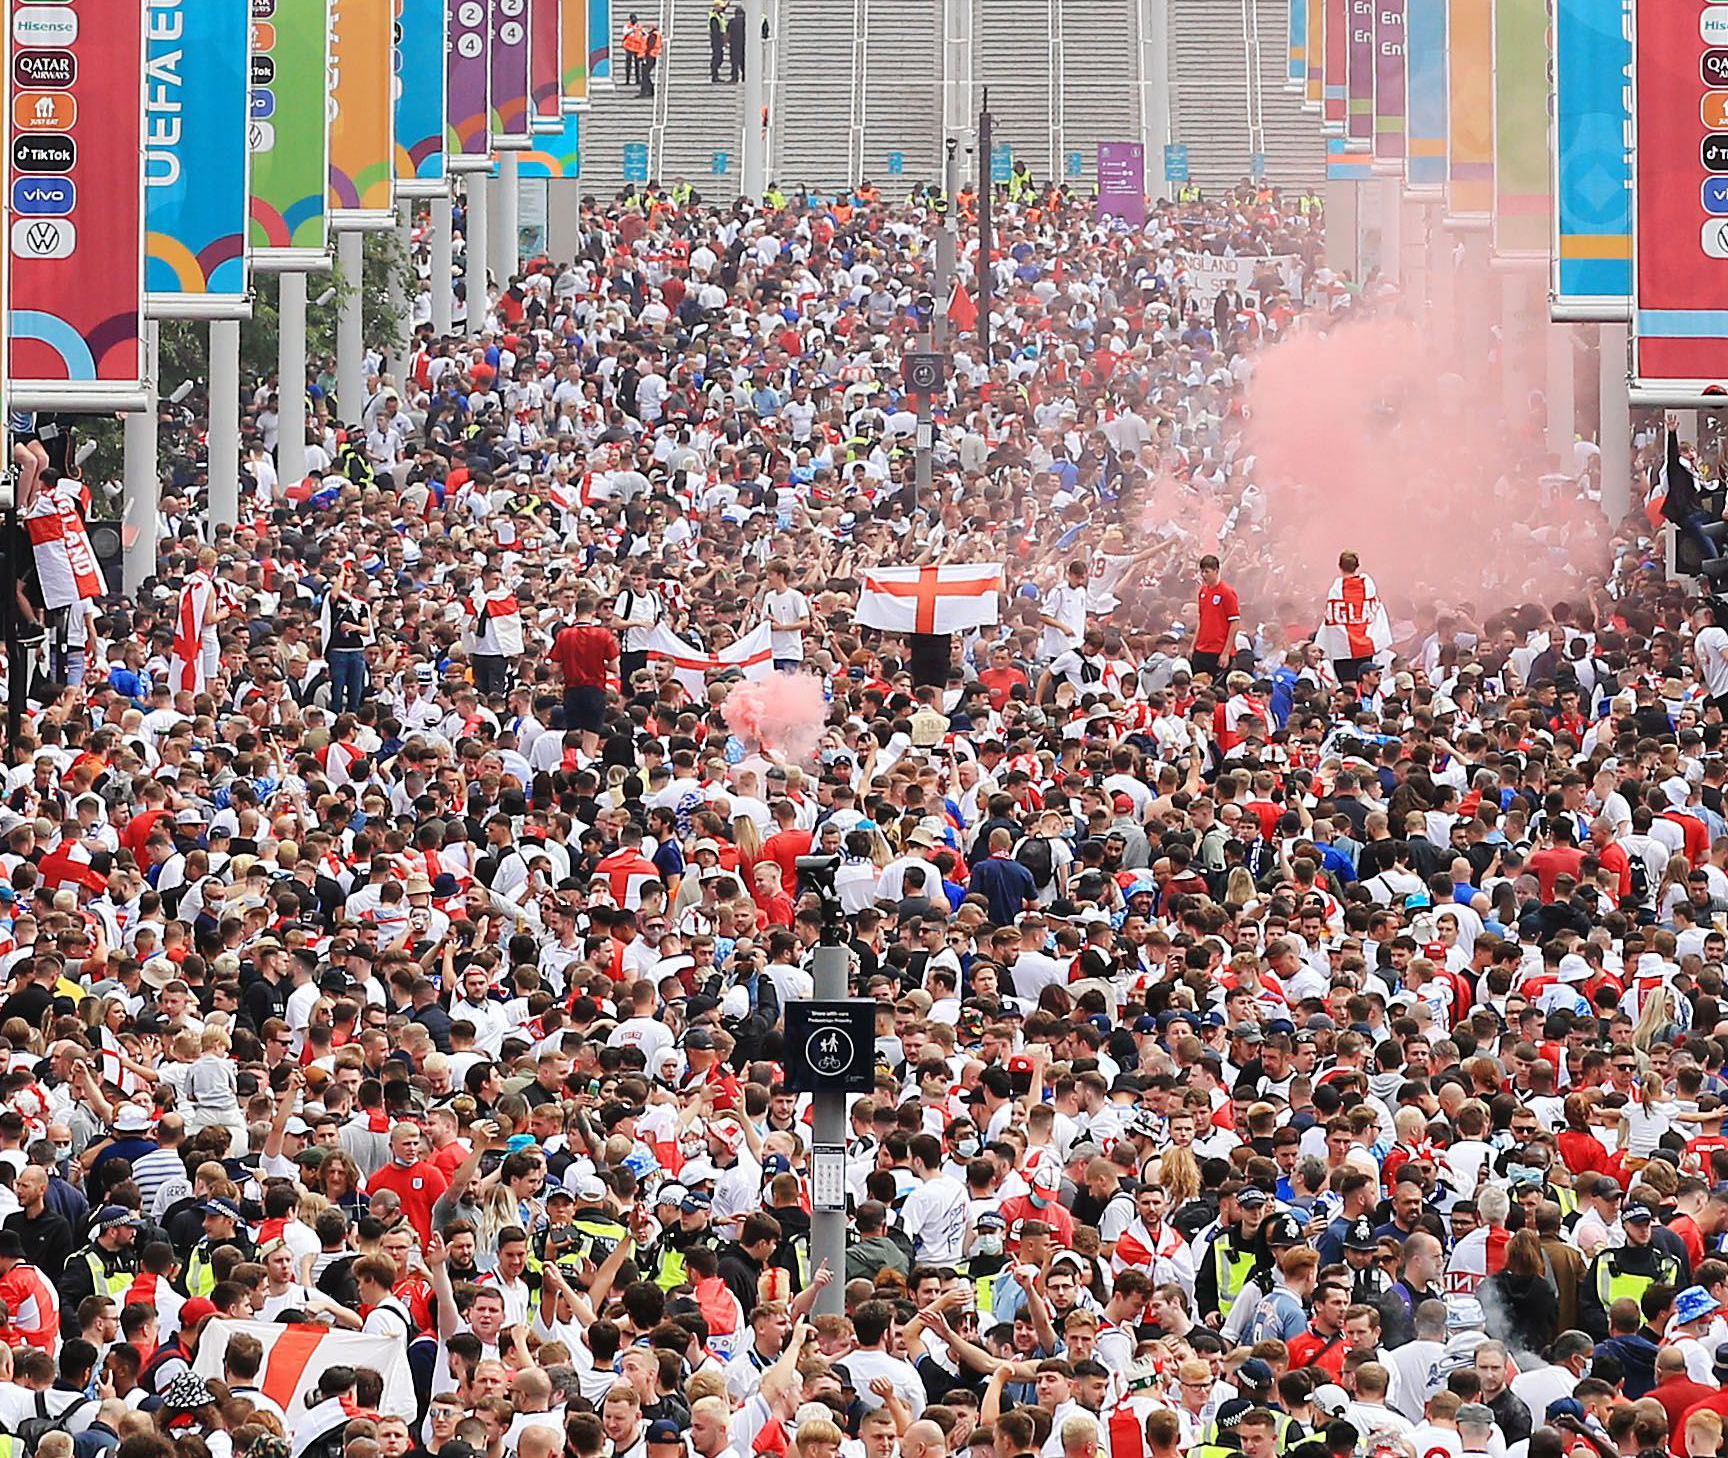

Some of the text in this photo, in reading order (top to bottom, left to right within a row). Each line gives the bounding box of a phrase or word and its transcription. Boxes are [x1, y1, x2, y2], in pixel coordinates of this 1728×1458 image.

[508, 0, 517, 10] 2
[466, 8, 475, 20] 2
[18, 21, 73, 32] Hisense
[507, 27, 516, 38] 4
[465, 39, 475, 51] 4
[20, 58, 70, 73] QATAR
[31, 70, 70, 80] AIRWAYS
[144, 49, 183, 187] UEFA
[31, 149, 71, 161] TikTok
[24, 189, 64, 201] vivo
